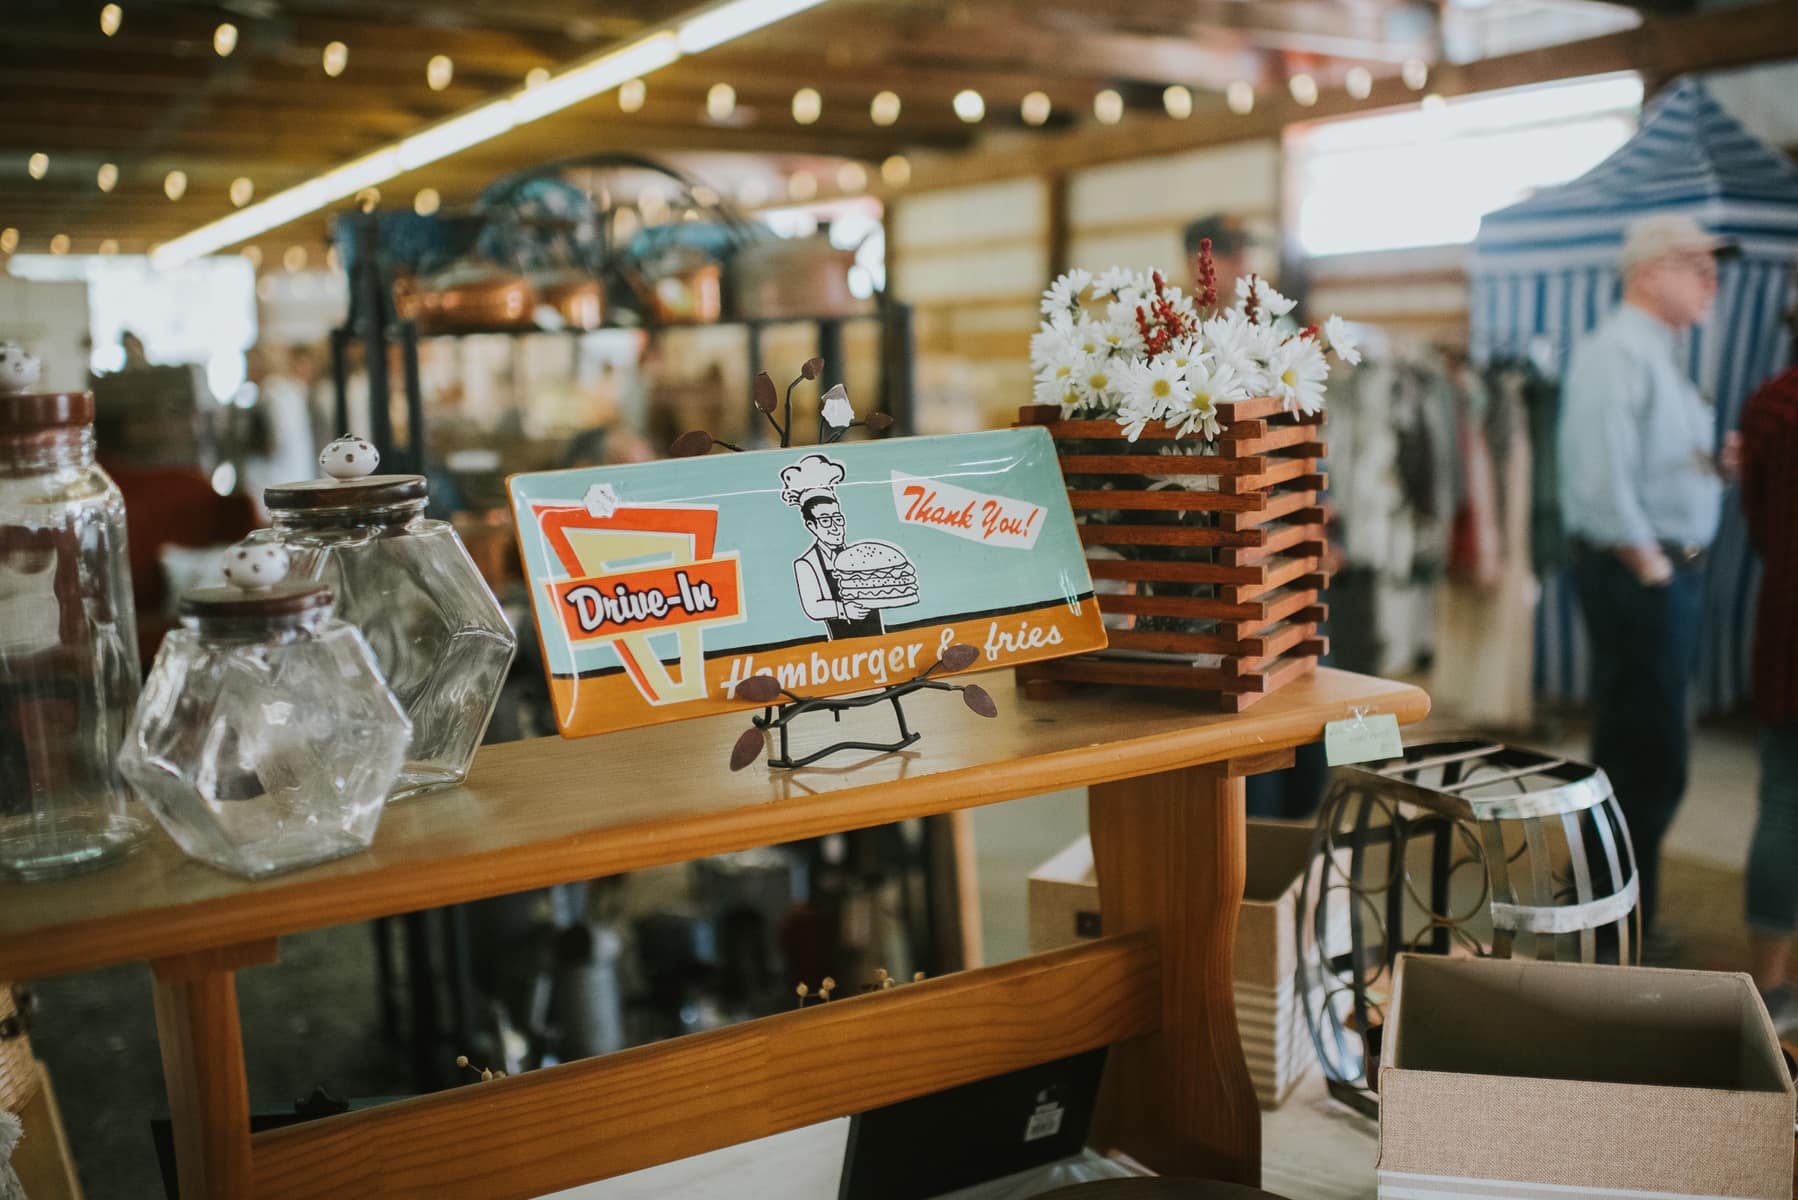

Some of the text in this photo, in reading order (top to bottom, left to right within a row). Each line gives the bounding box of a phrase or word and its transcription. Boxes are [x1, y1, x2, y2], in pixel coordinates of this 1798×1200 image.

[903, 485, 1040, 539] Thank You!
[565, 571, 718, 633] Drive-In
[984, 621, 1063, 661] fries
